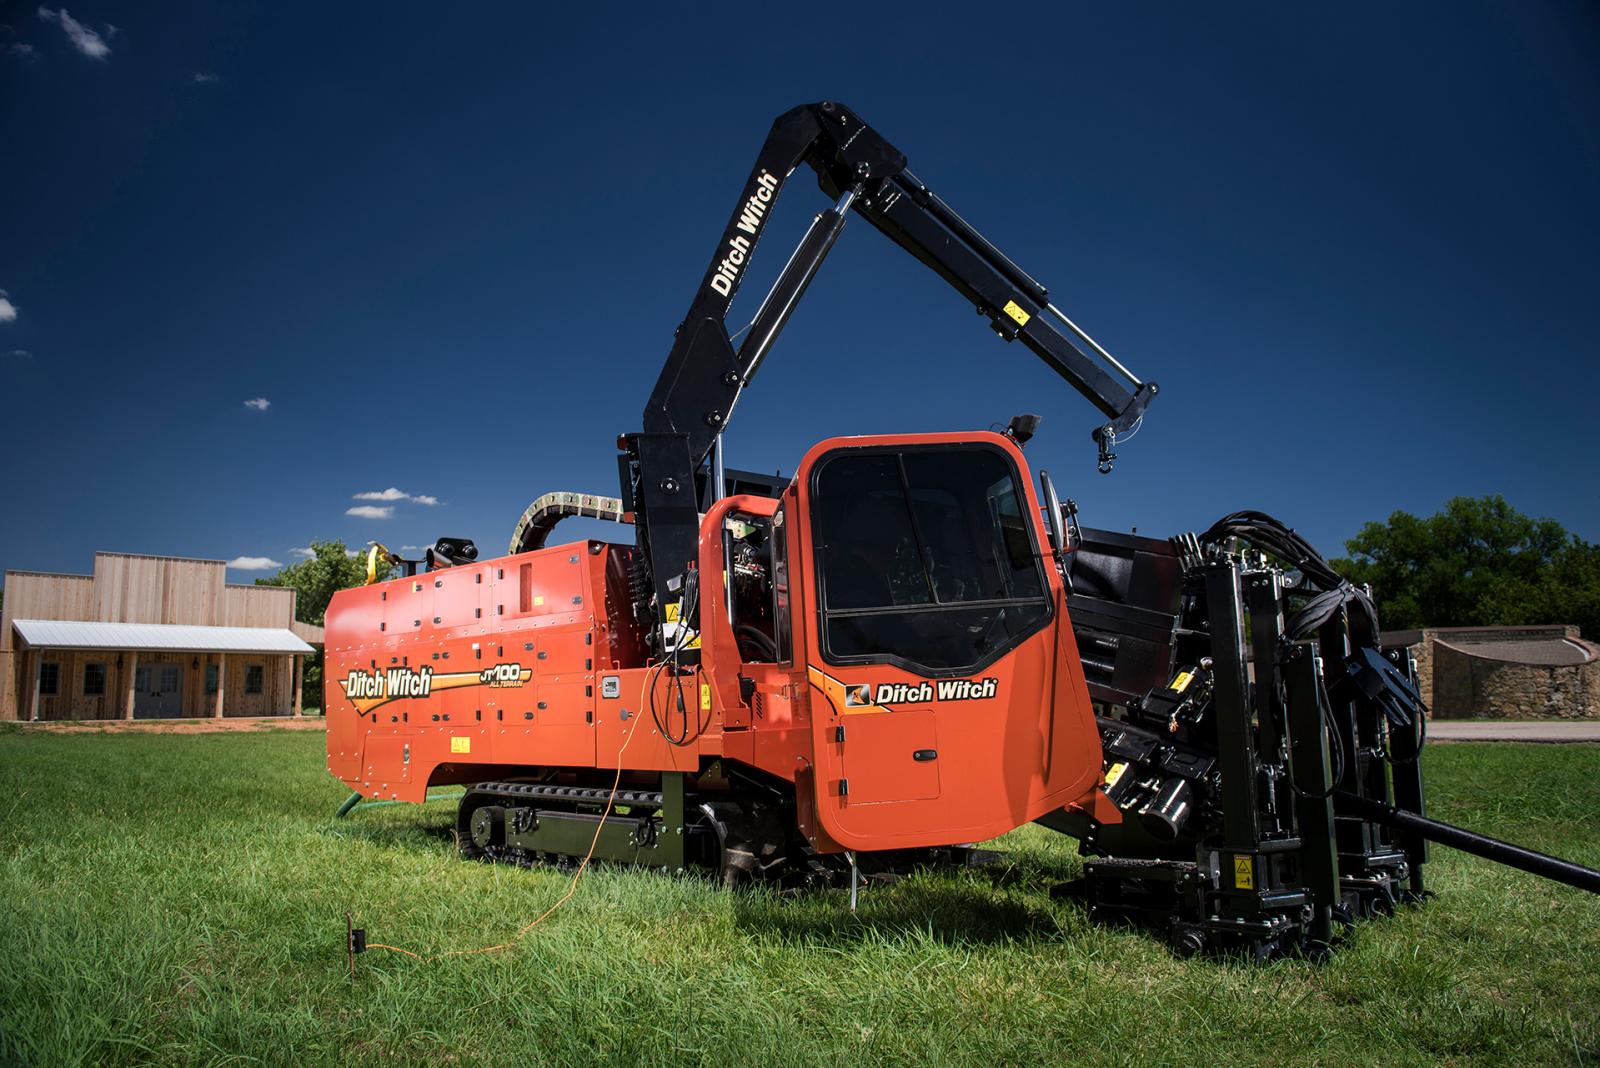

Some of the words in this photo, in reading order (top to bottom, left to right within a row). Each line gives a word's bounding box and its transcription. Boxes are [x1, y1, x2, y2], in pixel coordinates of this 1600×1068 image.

[710, 236, 750, 297] Ditch
[736, 171, 778, 234] Witch
[347, 670, 384, 697] Ditch
[387, 667, 431, 696] Witch
[480, 664, 520, 681] JT100
[876, 683, 933, 704] Ditch
[938, 679, 995, 700] Witch
